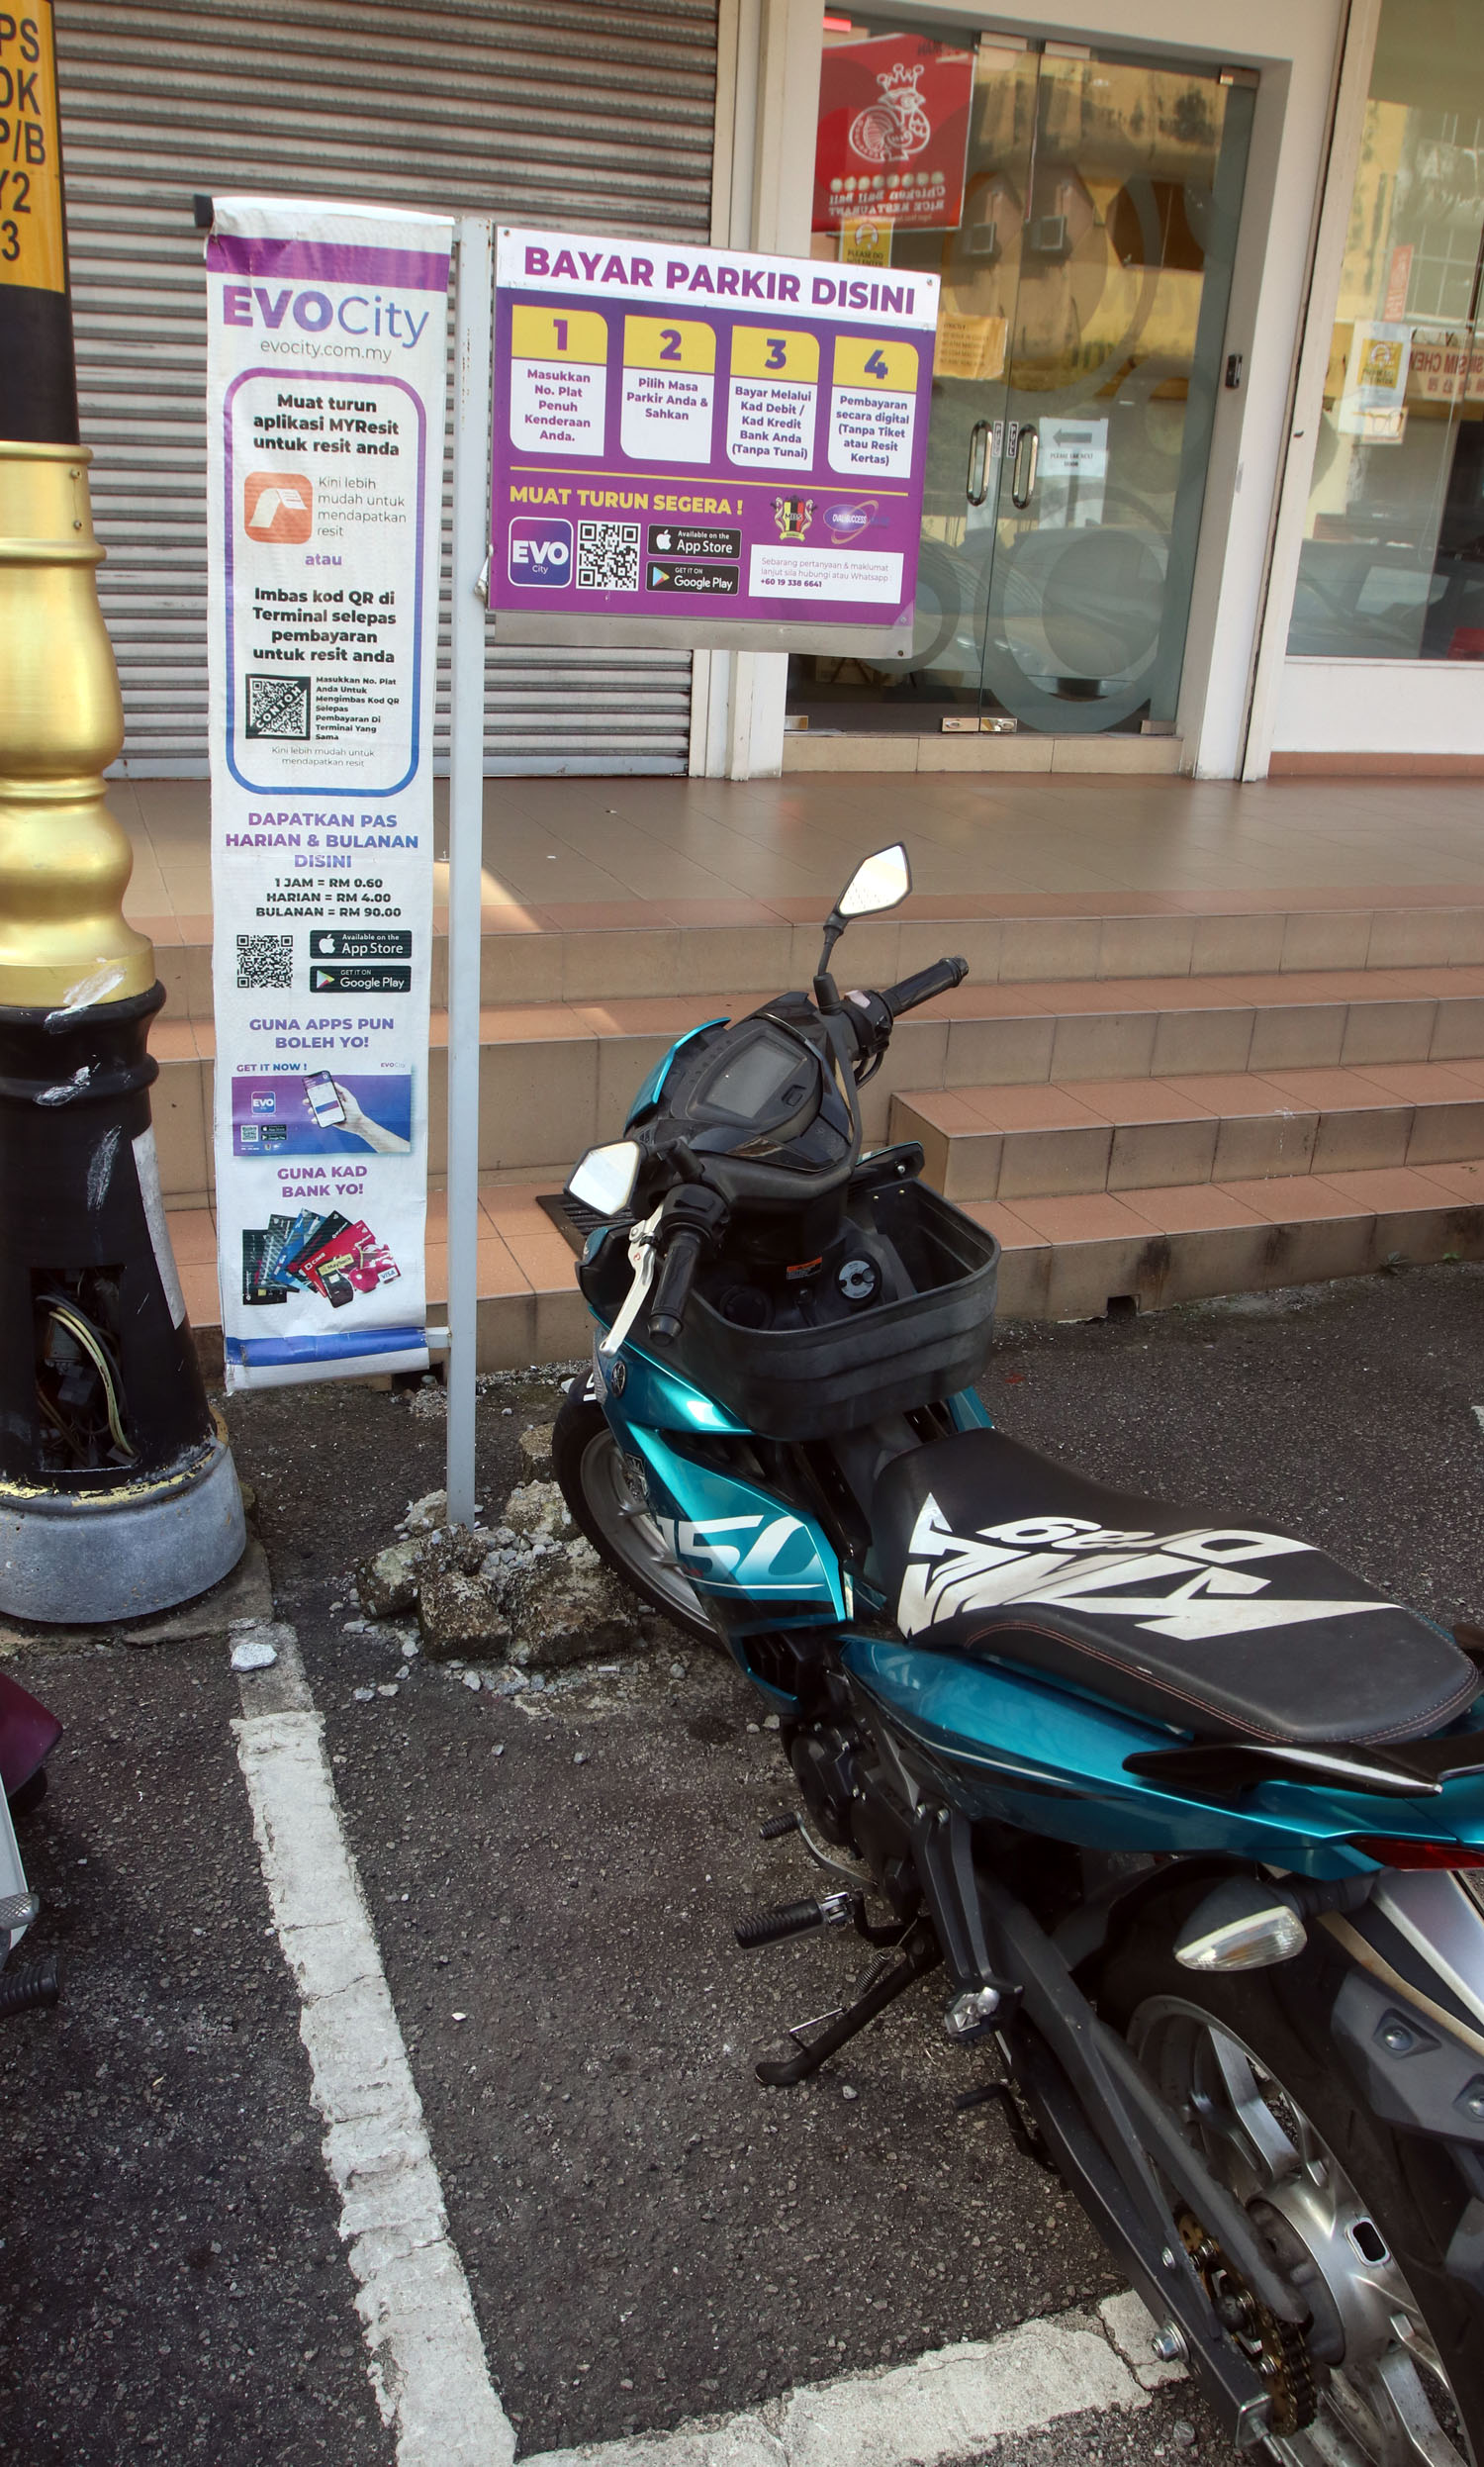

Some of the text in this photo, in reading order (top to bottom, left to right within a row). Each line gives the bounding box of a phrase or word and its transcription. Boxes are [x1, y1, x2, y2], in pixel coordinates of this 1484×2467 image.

[524, 245, 915, 315] BAYAR PARKIR DISINI
[223, 284, 429, 349] EVOCity
[553, 319, 568, 351] 1
[260, 339, 392, 363] evocity.com.my
[660, 330, 682, 361] 2
[765, 338, 787, 370] 3
[864, 349, 888, 380] 4
[527, 369, 591, 383] Masukkan
[534, 384, 583, 398] No. Plat
[638, 377, 698, 392] Pilih Masa
[626, 392, 696, 407] Parkir Anda
[735, 386, 811, 402] Bayar Melalui
[277, 394, 377, 413] Muat turun
[538, 400, 578, 412] Penuh
[741, 401, 796, 415] Kad Debit
[840, 395, 907, 410] Pembayaran
[524, 414, 591, 427] Kenderaan
[645, 408, 689, 421] Sahkan
[836, 411, 909, 425] secara digital
[253, 414, 399, 435] aplikasi MYResit
[742, 415, 802, 430] Kad Kredit
[539, 429, 575, 441] Anda.
[740, 429, 801, 443] Bank Anda
[838, 424, 905, 438] (Tanpa Tiket
[253, 437, 399, 456] untuk resit anda
[732, 443, 807, 460] (Tanpa Tunai)
[844, 439, 898, 451] atau Resit
[851, 452, 889, 467] Kertas)
[319, 476, 376, 490] Kini lebih
[318, 493, 405, 507] mudah untuk
[510, 485, 732, 515] MUAT TURUN SEGERA
[318, 510, 407, 523] mendapatkan
[318, 525, 343, 536] resit
[512, 539, 569, 565] EVO
[676, 538, 733, 554] App Store
[305, 553, 342, 566] atau
[762, 557, 888, 572] Sebarang pertanyaan maklumat
[532, 565, 548, 575] City
[761, 568, 783, 578] lanjut
[798, 570, 831, 579] hubungi
[851, 572, 888, 583] Whatsapp
[674, 573, 733, 591] Google Play
[255, 587, 395, 607] Imbas kod QR di
[252, 607, 397, 626] Terminal selepas
[272, 629, 377, 644] pembayaran
[253, 646, 395, 663] untuk resit anda
[316, 695, 365, 704] Mengimbas
[254, 685, 304, 730] CONTOH
[316, 705, 348, 713] Selepas
[316, 714, 369, 723] Pembayaran
[248, 812, 398, 828] DAPATKAN PAS
[226, 833, 418, 848] HARIAN & BULANAN
[295, 855, 351, 868] DISINI
[275, 878, 383, 889] 1 JAM RM 0.60
[267, 893, 391, 902] HARIAN RM 4.00
[256, 907, 402, 917] BULANAN RM 90.00
[342, 933, 375, 942] Available
[341, 942, 404, 957] App Store
[340, 978, 405, 990] Google Play
[249, 1018, 394, 1031] GUNA APPS PUN
[275, 1036, 369, 1049] BOLEH YO!
[236, 1064, 257, 1073] GET
[253, 1098, 274, 1108] EVO
[277, 1166, 367, 1180] GUNA KAD
[282, 1184, 363, 1197] BANK YO!
[381, 1270, 396, 1280] VISA
